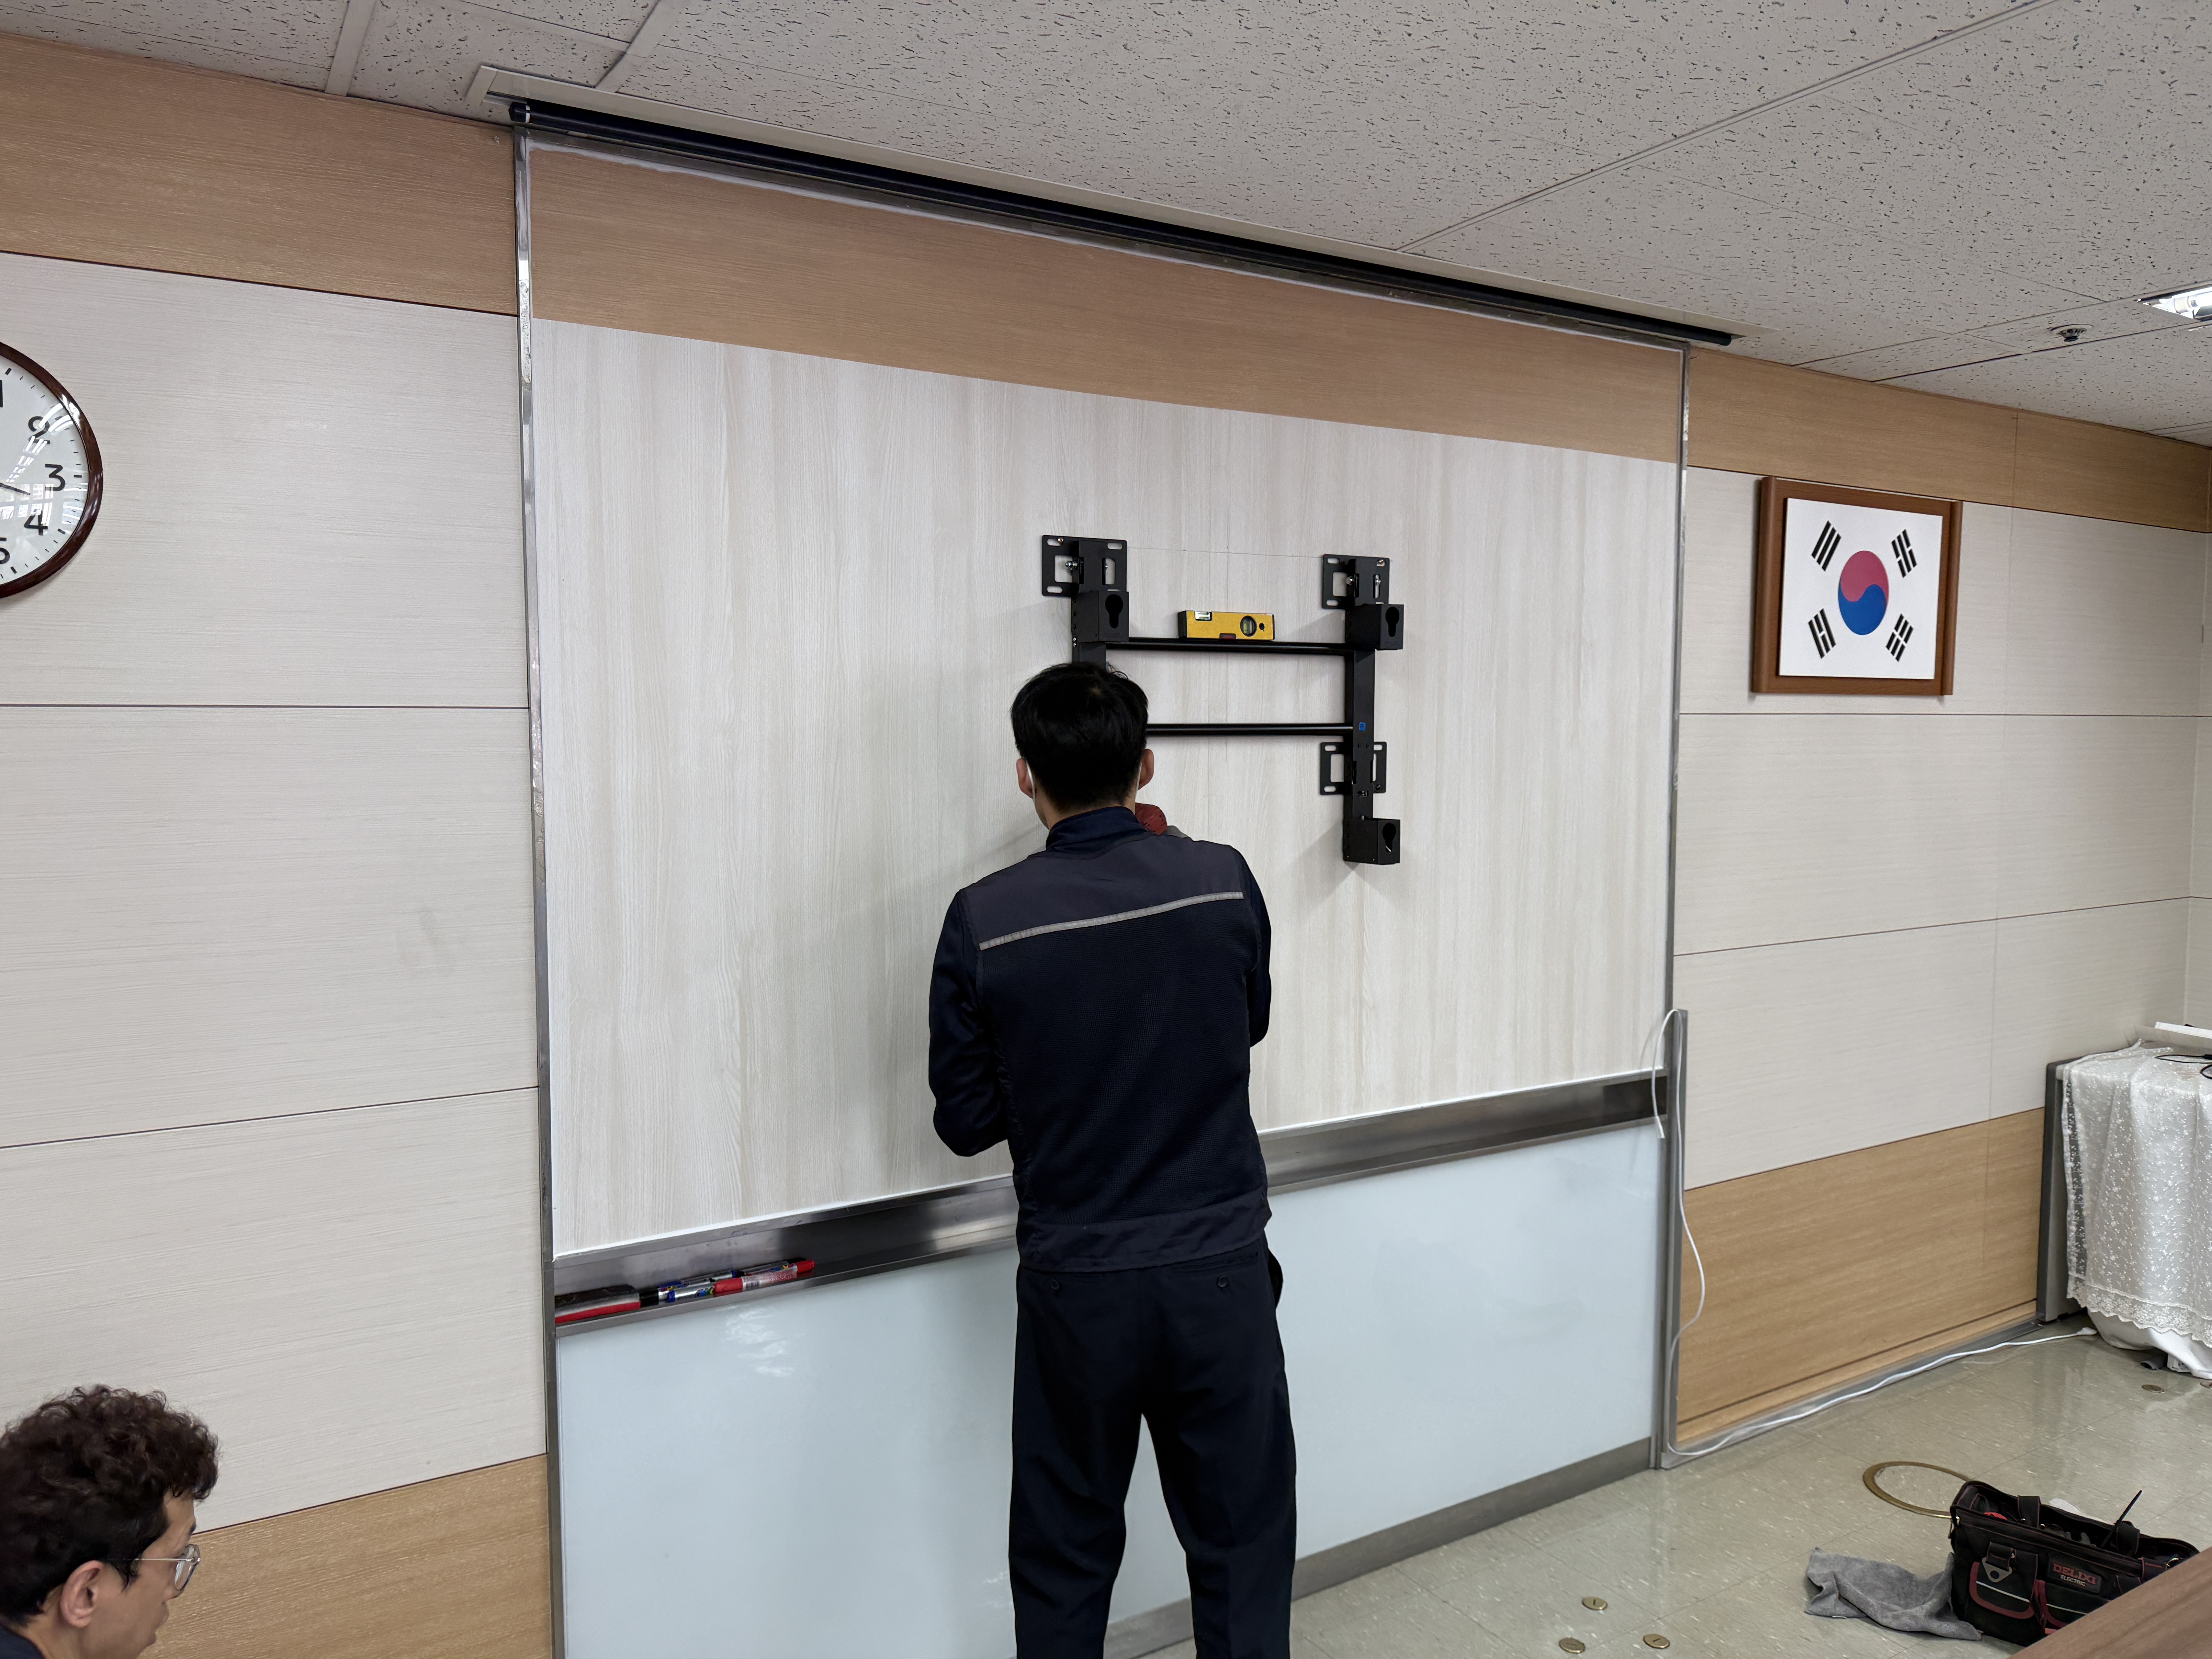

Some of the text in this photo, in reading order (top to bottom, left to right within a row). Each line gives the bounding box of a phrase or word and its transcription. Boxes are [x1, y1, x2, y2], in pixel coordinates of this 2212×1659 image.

[28, 416, 50, 444] 2
[45, 464, 65, 491] 3
[24, 509, 48, 536] 4
[2053, 1563, 2097, 1585] DELIXI
[2060, 1575, 2086, 1586] ELECTRIC
